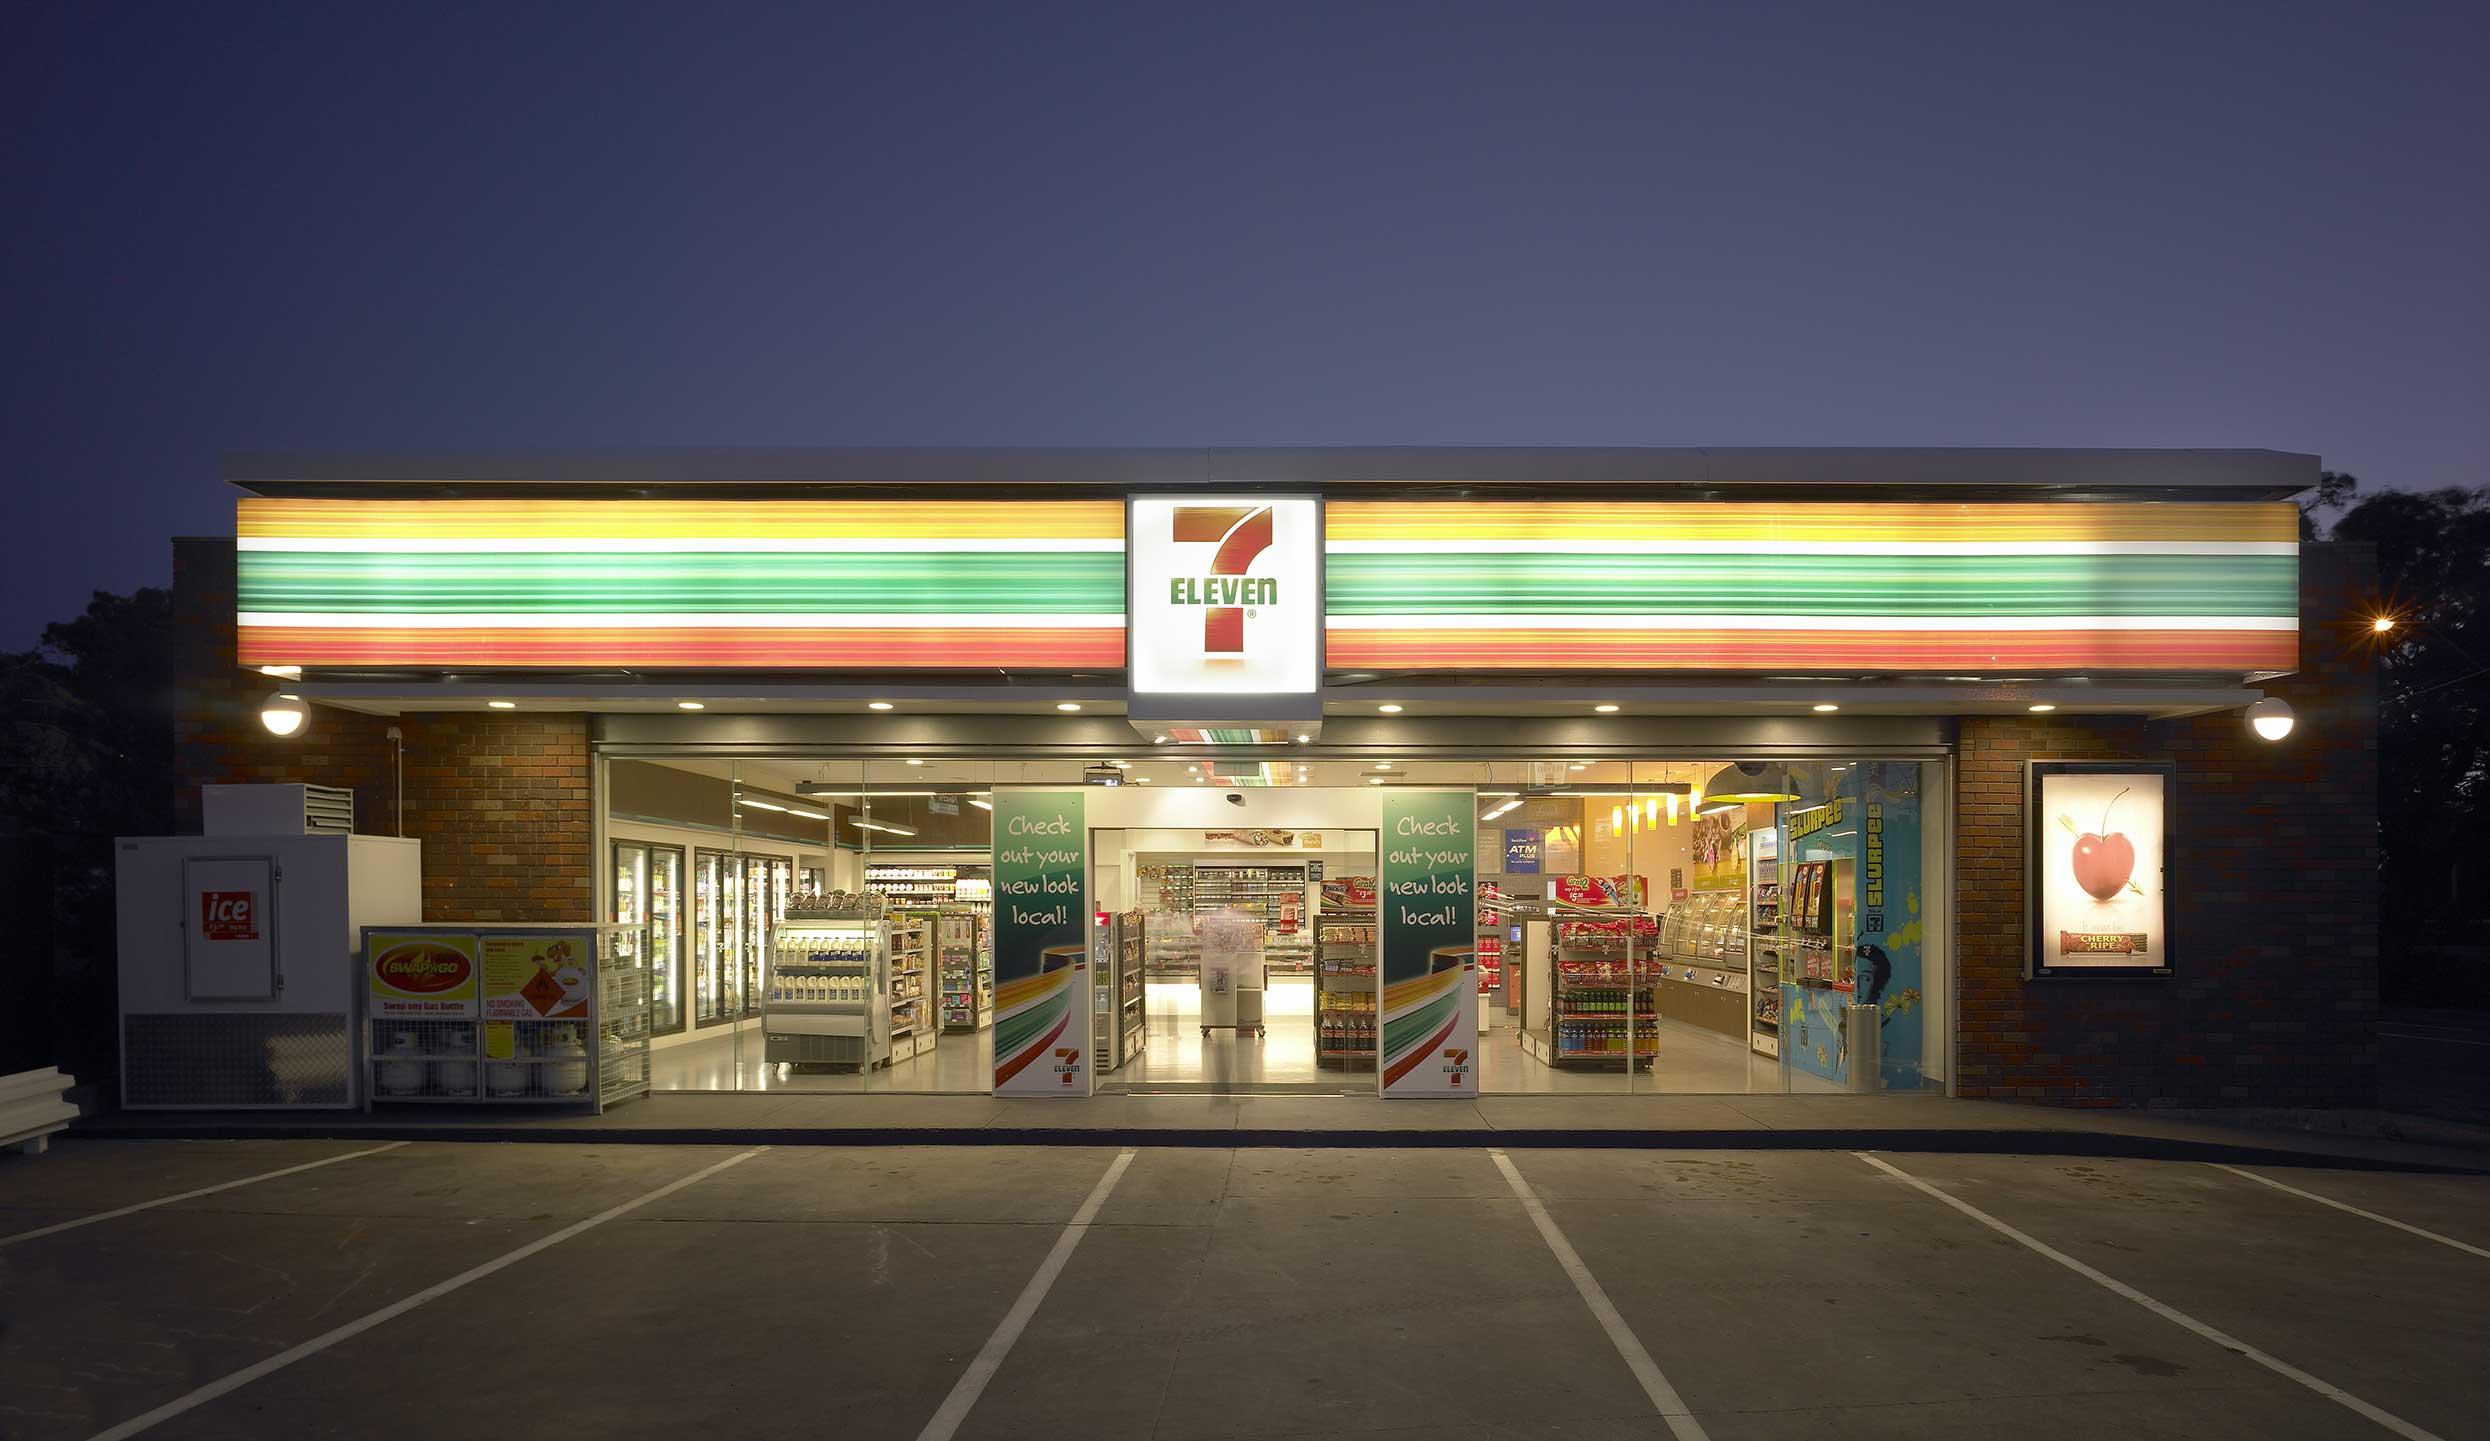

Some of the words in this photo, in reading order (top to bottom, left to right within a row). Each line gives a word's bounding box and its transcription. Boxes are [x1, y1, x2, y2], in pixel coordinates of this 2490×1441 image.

[1172, 505, 1273, 653] 7
[1008, 814, 1071, 836] Check
[1396, 814, 1460, 836] Check
[1000, 846, 1033, 864] out
[1036, 850, 1080, 870] your
[1389, 846, 1422, 865] out
[1425, 850, 1468, 870] your
[1509, 845, 1537, 854] ATM
[1001, 879, 1039, 895] new
[1042, 874, 1080, 895] look
[1389, 880, 1428, 895] new
[1431, 874, 1468, 895] look
[208, 893, 249, 921] ice
[1012, 905, 1067, 926] local!
[1400, 905, 1457, 926] local!
[384, 1002, 406, 1011] Swap
[424, 1002, 439, 1010] Gas
[440, 1002, 464, 1010] Bottle
[486, 1000, 496, 1008] NO
[497, 1000, 525, 1008] SMOKING
[486, 1009, 520, 1017] FLAMMABLE
[521, 1009, 533, 1017] GAS
